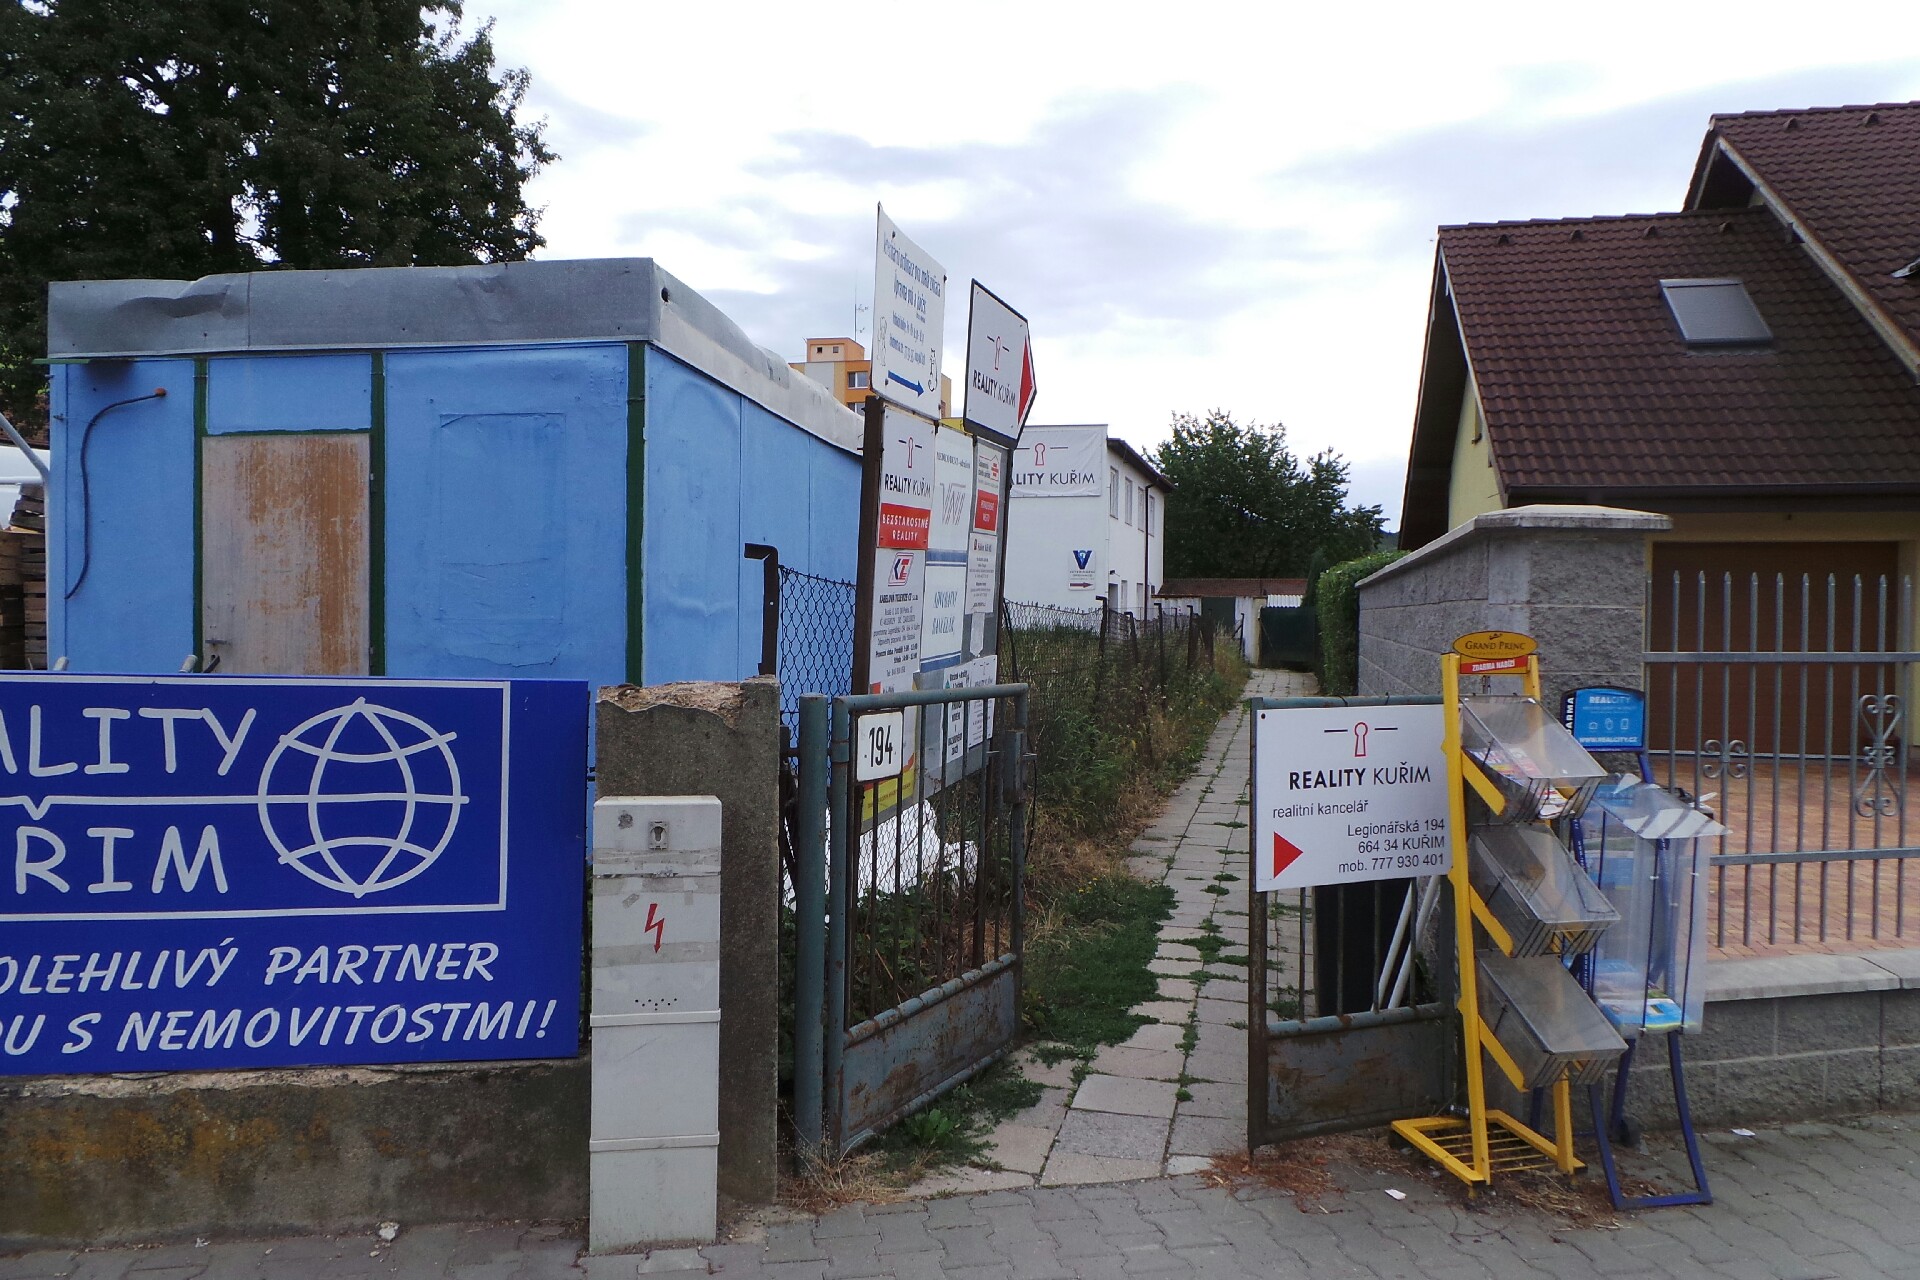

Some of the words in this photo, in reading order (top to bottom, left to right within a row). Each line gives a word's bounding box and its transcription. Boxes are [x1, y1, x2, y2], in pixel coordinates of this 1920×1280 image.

[972, 369, 998, 399] REALITY
[998, 382, 1016, 408] KUŘIM
[884, 473, 912, 494] REALITY
[912, 477, 931, 498] KUŘIM
[1012, 472, 1045, 486] LITY
[1050, 469, 1095, 485] KUŘIM
[882, 513, 929, 529] BEZSTAROSTNÉ
[892, 529, 918, 541] REALITY
[1464, 640, 1496, 650] GRAND
[1499, 640, 1526, 650] PRINC
[1472, 663, 1495, 672] ZDARMA
[1589, 696, 1632, 704] REALCITY
[1565, 697, 1574, 736] DARMA
[0, 704, 257, 777] LITY
[868, 724, 893, 768] 194
[1289, 767, 1367, 790] REALITY
[1373, 761, 1431, 785] KUŘIM
[1272, 802, 1314, 819] realitní
[1317, 799, 1369, 816] kancelář
[1347, 819, 1420, 839] Legionářská
[1424, 818, 1445, 831] 194
[15, 797, 228, 895] ŘIM
[1358, 841, 1379, 854] 664
[1383, 839, 1399, 852] 34
[1402, 834, 1445, 850] KUŘIM
[1338, 858, 1368, 873] mob.
[1372, 857, 1393, 870] 777
[1397, 855, 1419, 869] 930
[1423, 853, 1444, 866] 401
[0, 937, 238, 995] OLEHLIVÝ
[263, 942, 499, 985] PARTNER
[0, 1013, 46, 1056] U
[61, 1012, 102, 1054] S
[116, 999, 557, 1053] NEMOVITOSTMI!
